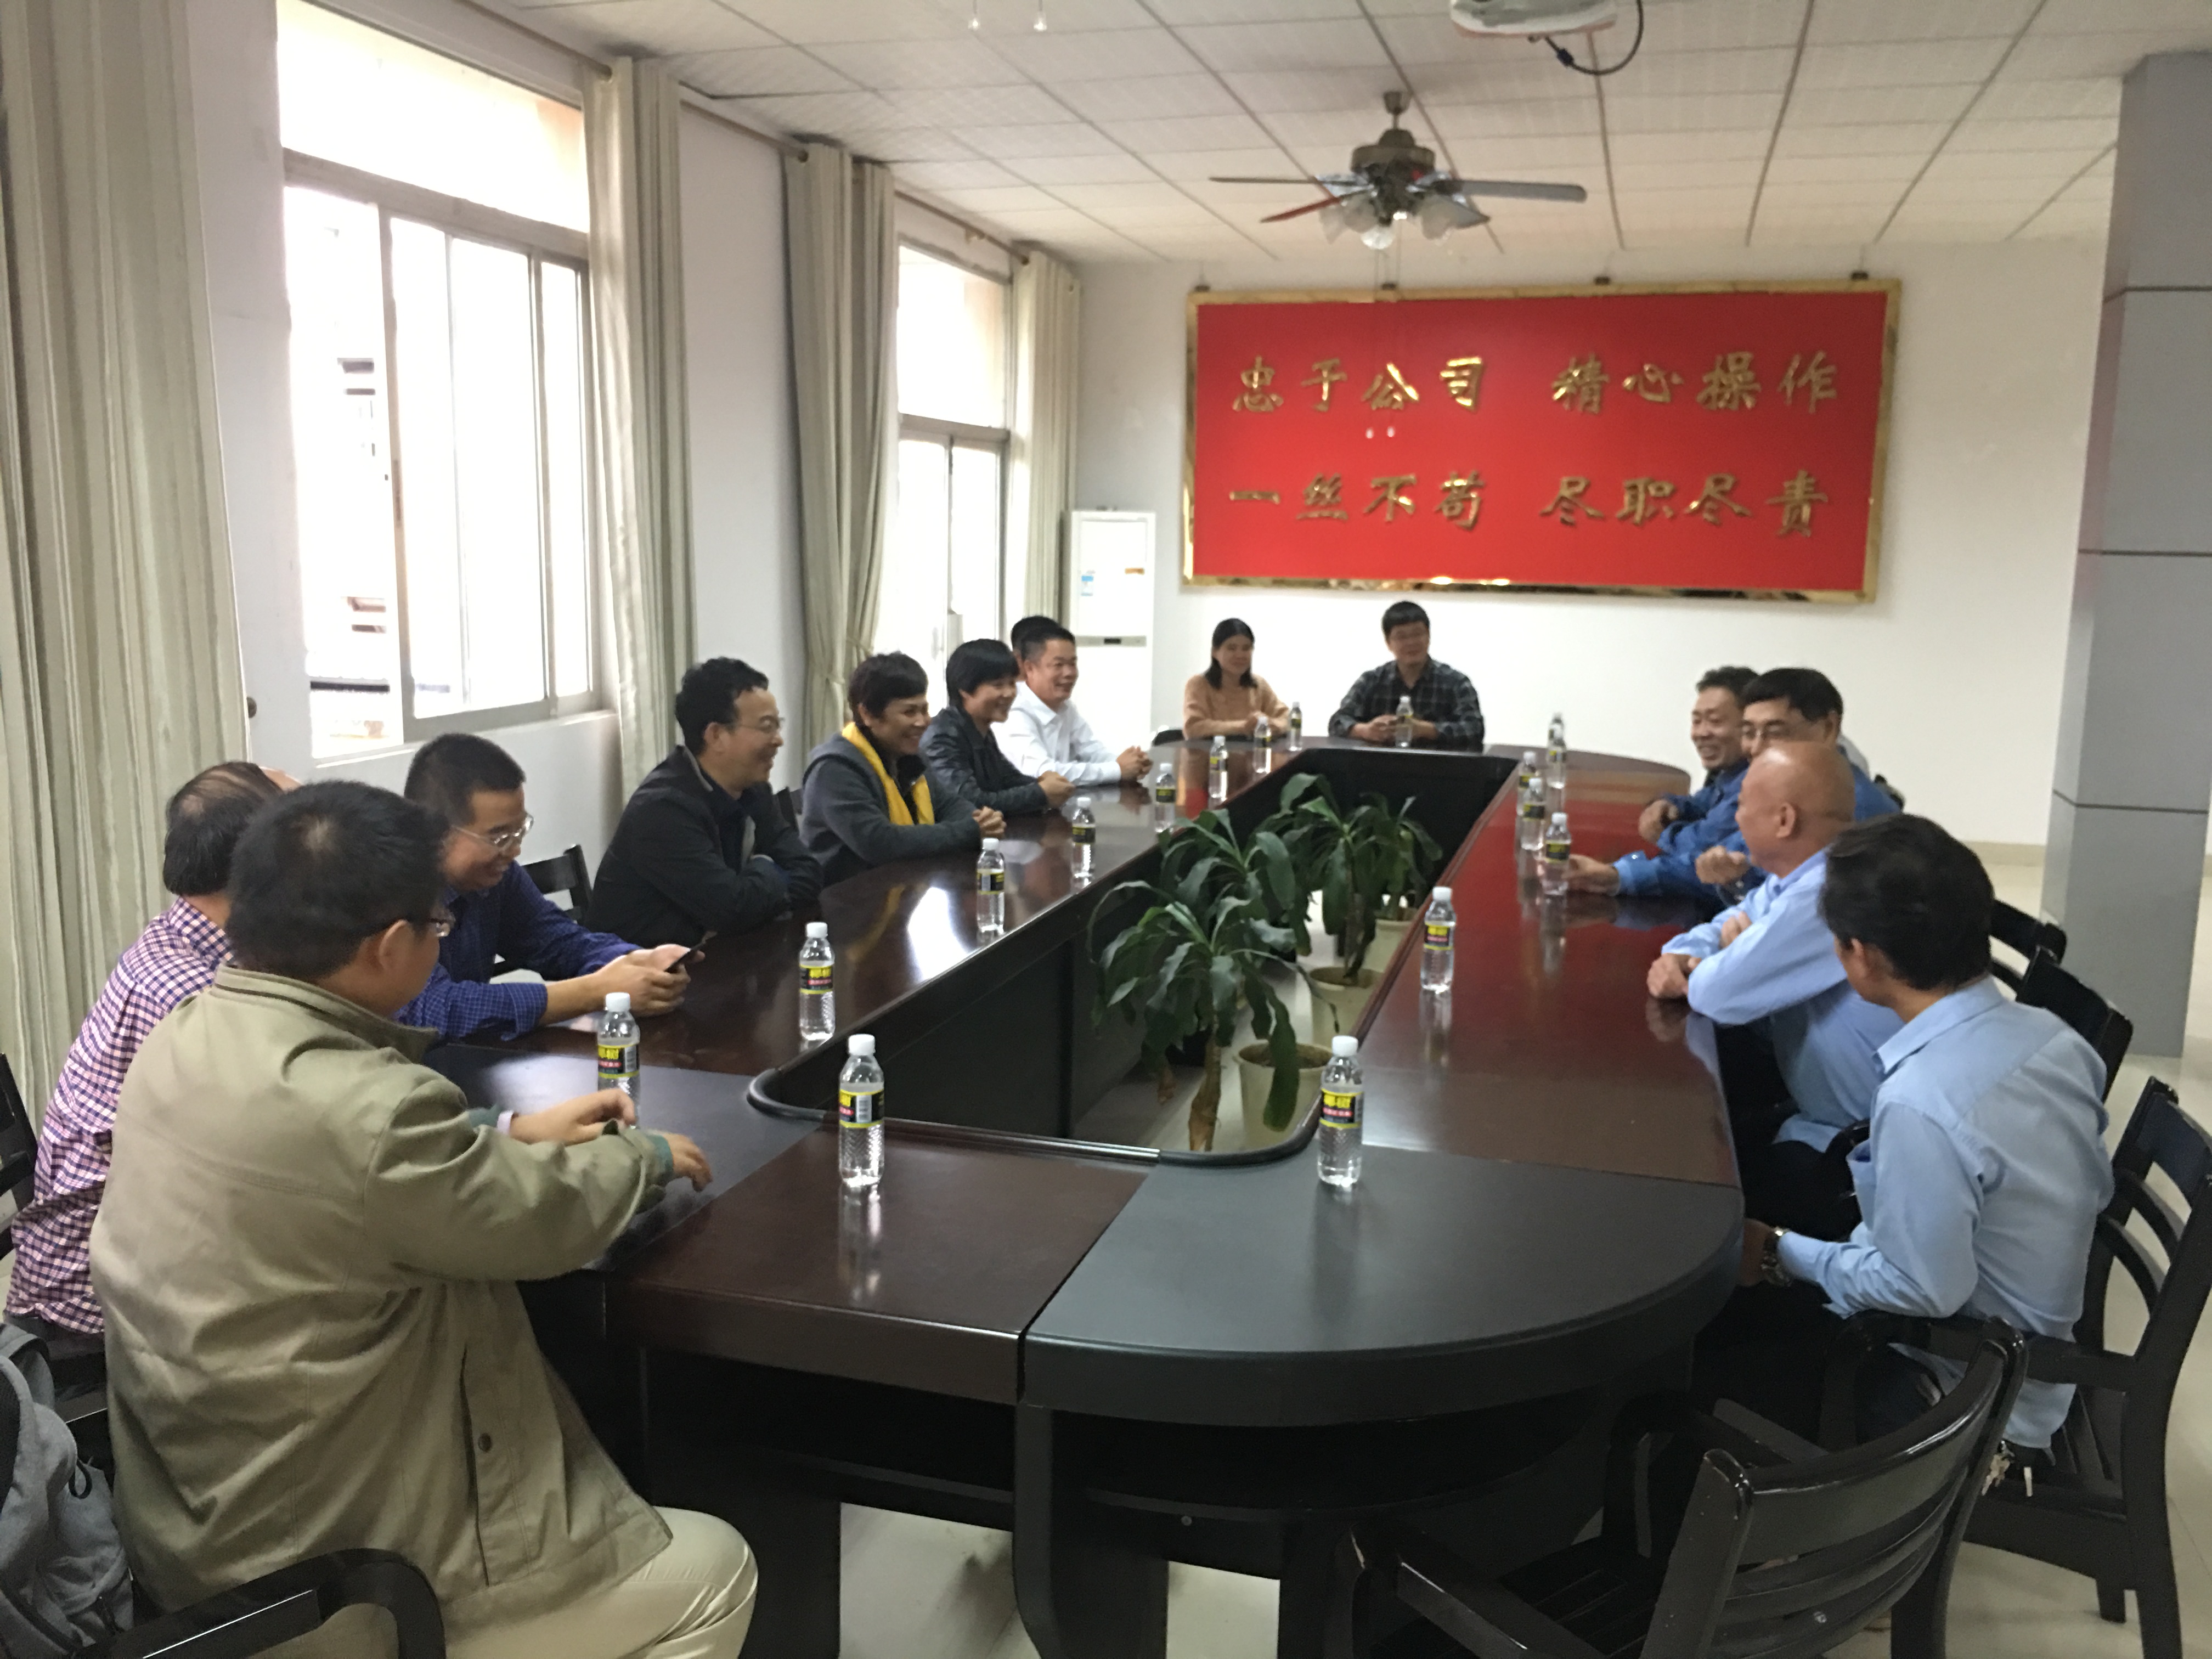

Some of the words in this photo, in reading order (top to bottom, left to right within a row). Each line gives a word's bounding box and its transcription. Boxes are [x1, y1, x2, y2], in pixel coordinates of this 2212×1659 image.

[1232, 354, 1485, 413] 忠于公司
[1550, 350, 1837, 414] 精心操作
[1228, 469, 1485, 529] 一丝不苟
[1539, 468, 1829, 538] 尽职尽责
